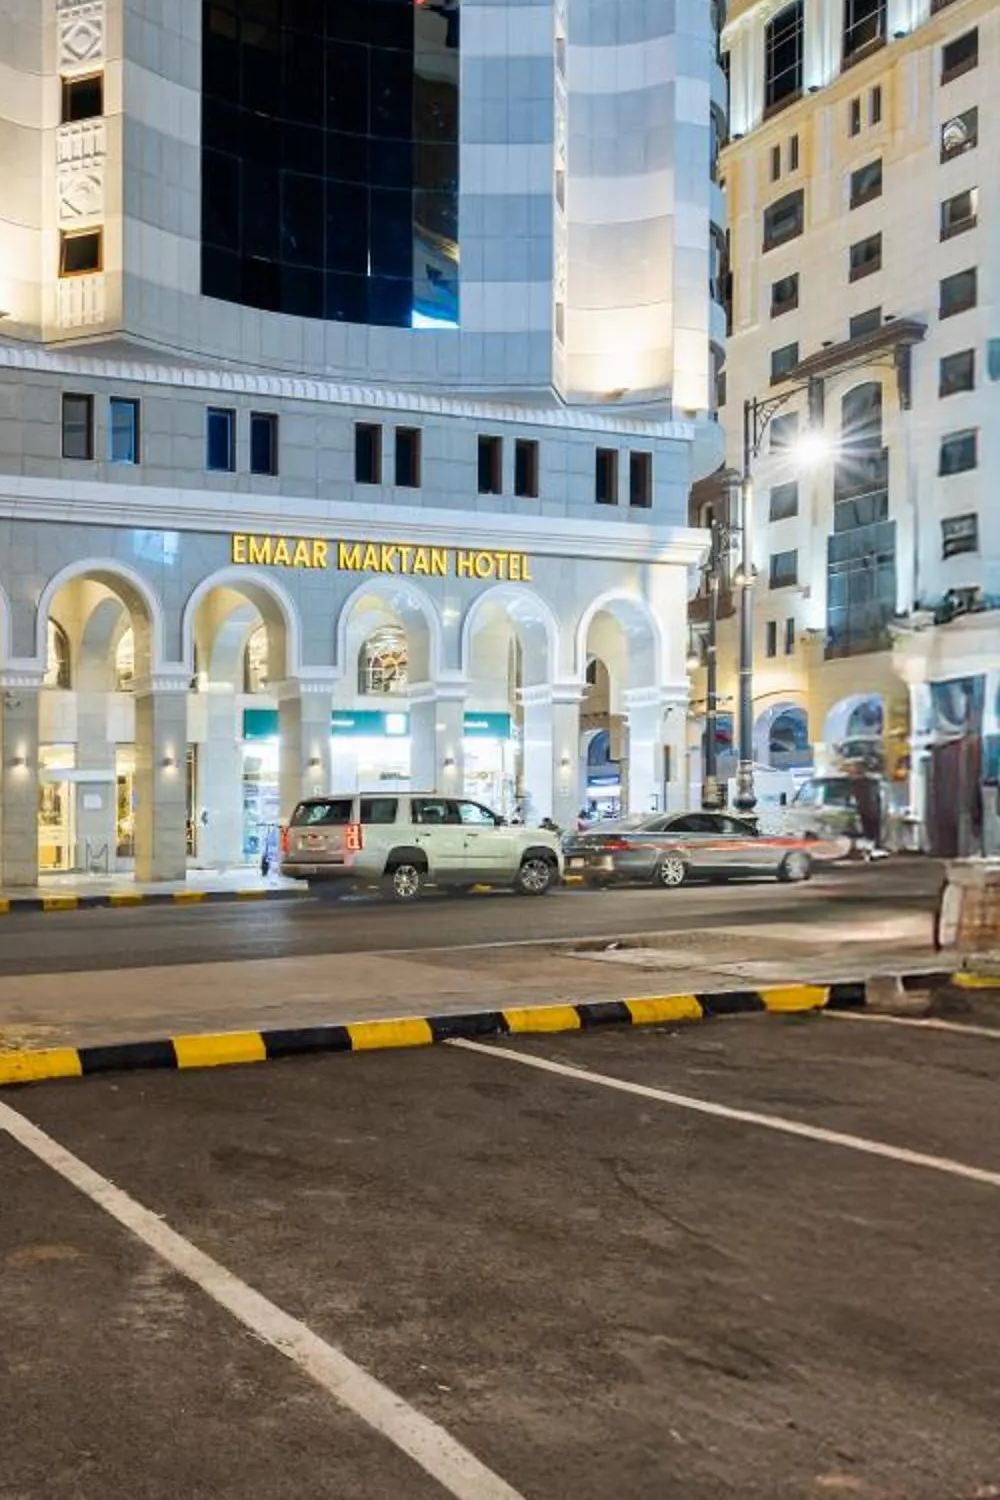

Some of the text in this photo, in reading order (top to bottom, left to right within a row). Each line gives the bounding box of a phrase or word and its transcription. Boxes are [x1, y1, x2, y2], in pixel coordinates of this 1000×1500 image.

[232, 534, 532, 581] EMAAR MAKTAN HOTEL
